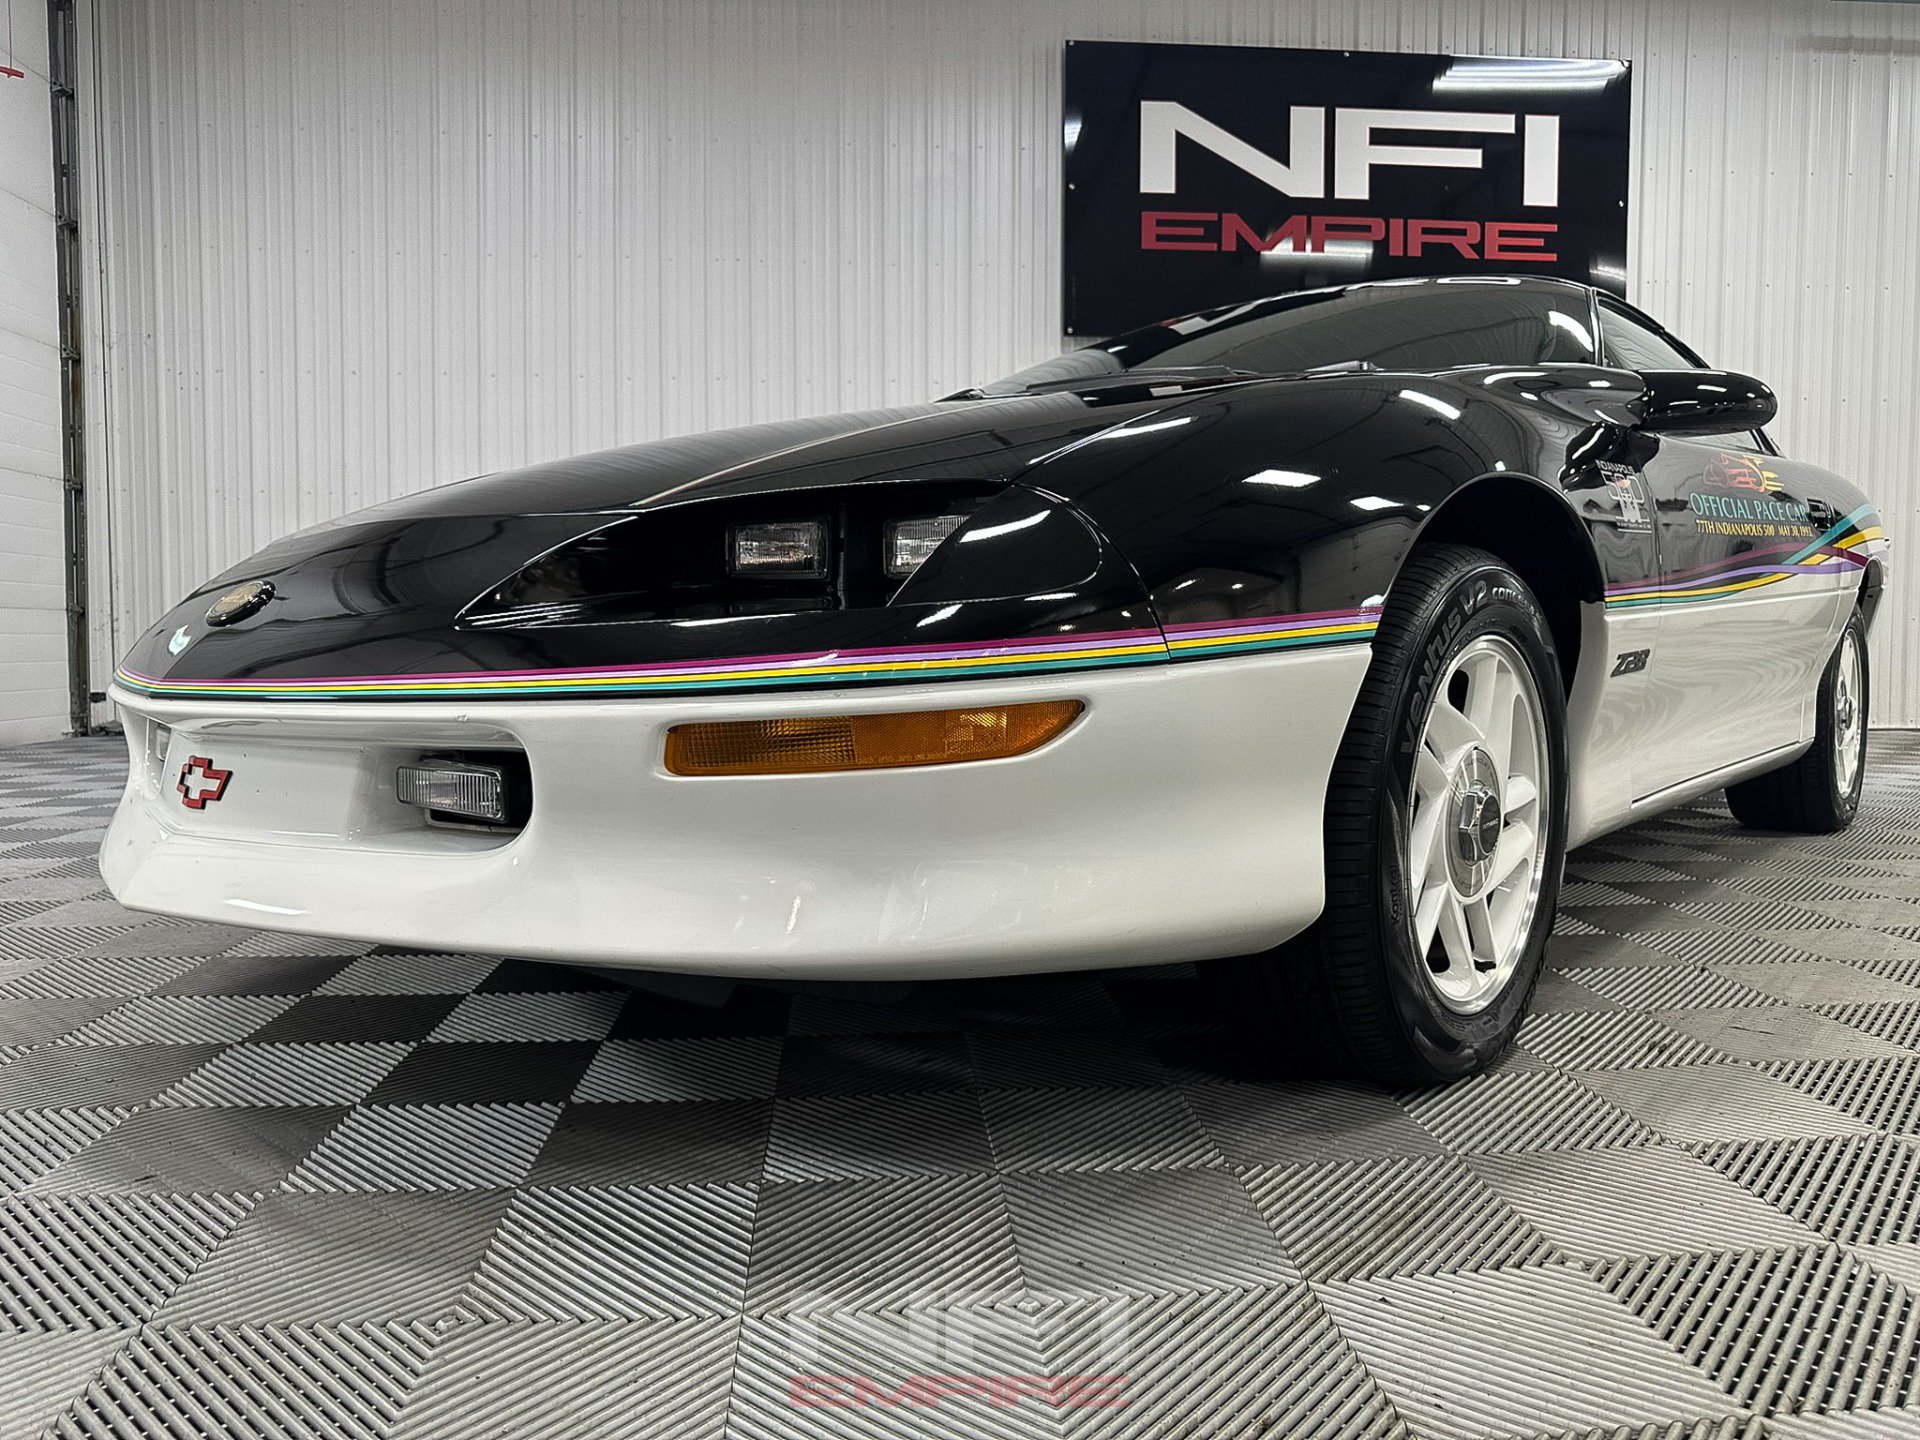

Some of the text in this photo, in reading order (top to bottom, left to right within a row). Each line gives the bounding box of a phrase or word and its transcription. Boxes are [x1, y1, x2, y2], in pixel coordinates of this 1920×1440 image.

[1140, 100, 1560, 207] NFI
[1141, 211, 1558, 262] EMPIRE
[1690, 493, 1809, 522] OFFICIAL PACE CAR
[1696, 520, 1714, 534] 77TH
[1715, 522, 1763, 536] INDIANAPOLIS
[1763, 524, 1775, 536] 500
[1778, 525, 1791, 536] MAY
[1459, 580, 1489, 615] V2
[1610, 649, 1650, 678] Z28
